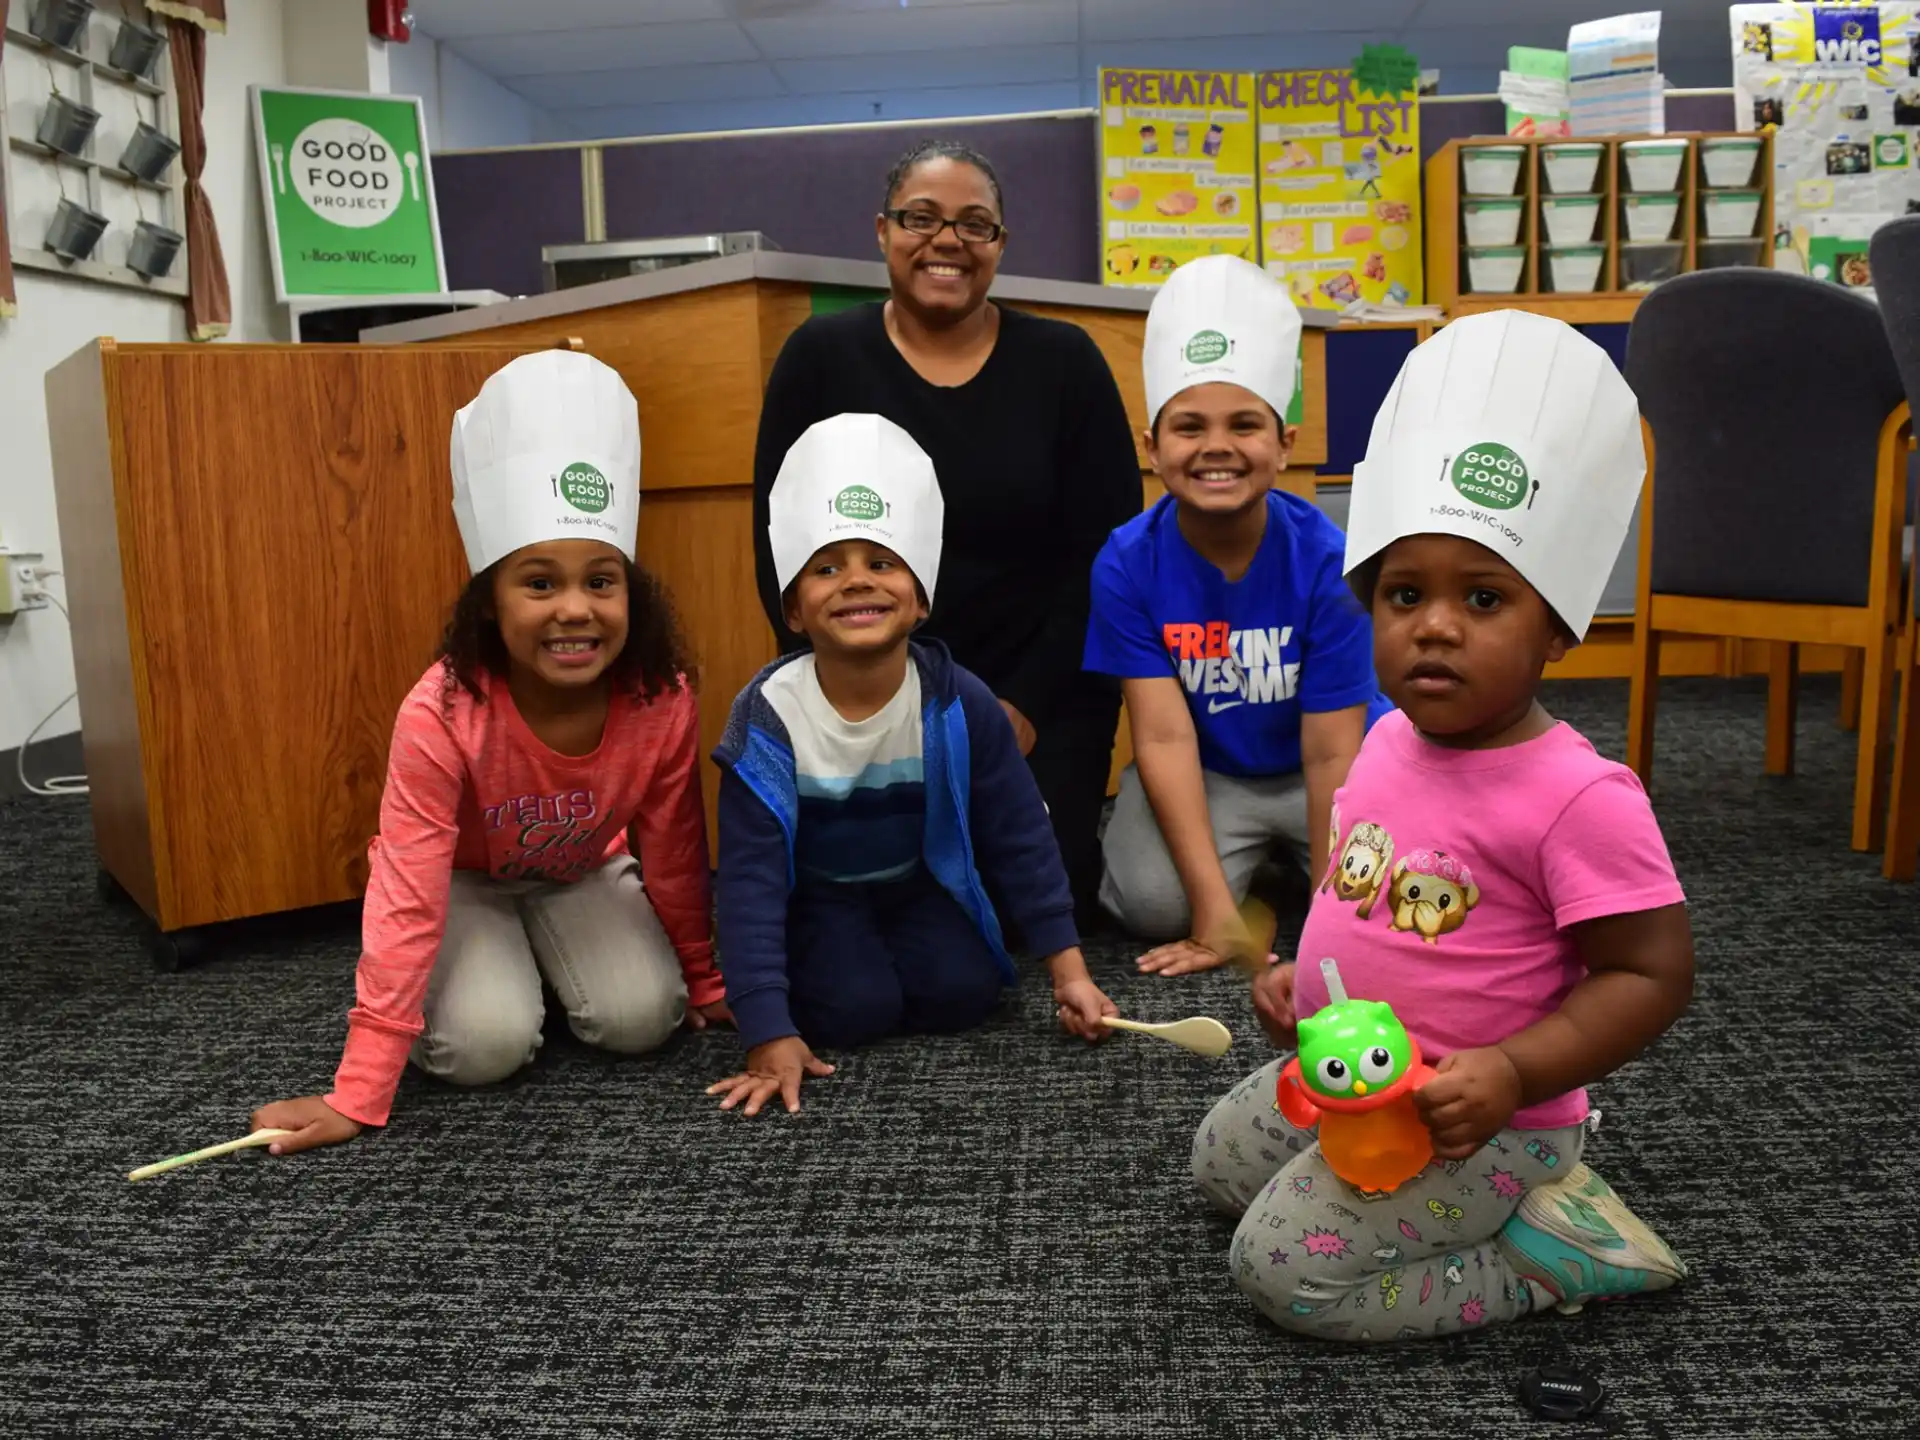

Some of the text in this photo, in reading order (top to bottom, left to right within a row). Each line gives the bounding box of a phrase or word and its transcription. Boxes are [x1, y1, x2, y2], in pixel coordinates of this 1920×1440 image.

[1815, 39, 1881, 62] WIC
[1103, 71, 1355, 109] PRENATAL CHECK
[1338, 100, 1414, 138] LIST
[302, 139, 387, 163] GOOD
[308, 168, 390, 190] FOOD
[313, 195, 388, 210] PROJECT
[301, 248, 417, 269] 1-800-WIC-1007
[1464, 451, 1524, 478] GOOD
[565, 471, 604, 485] GOOD
[1461, 467, 1518, 494] FOOD
[567, 484, 605, 498] FOOD
[840, 491, 879, 502] GOOD
[1459, 483, 1513, 505] PROJECT
[570, 497, 605, 508] PROJECT
[841, 501, 879, 511] FOOD
[1429, 504, 1524, 547] 1-800-WIC-1007
[1541, 1381, 1582, 1392] Nikon
